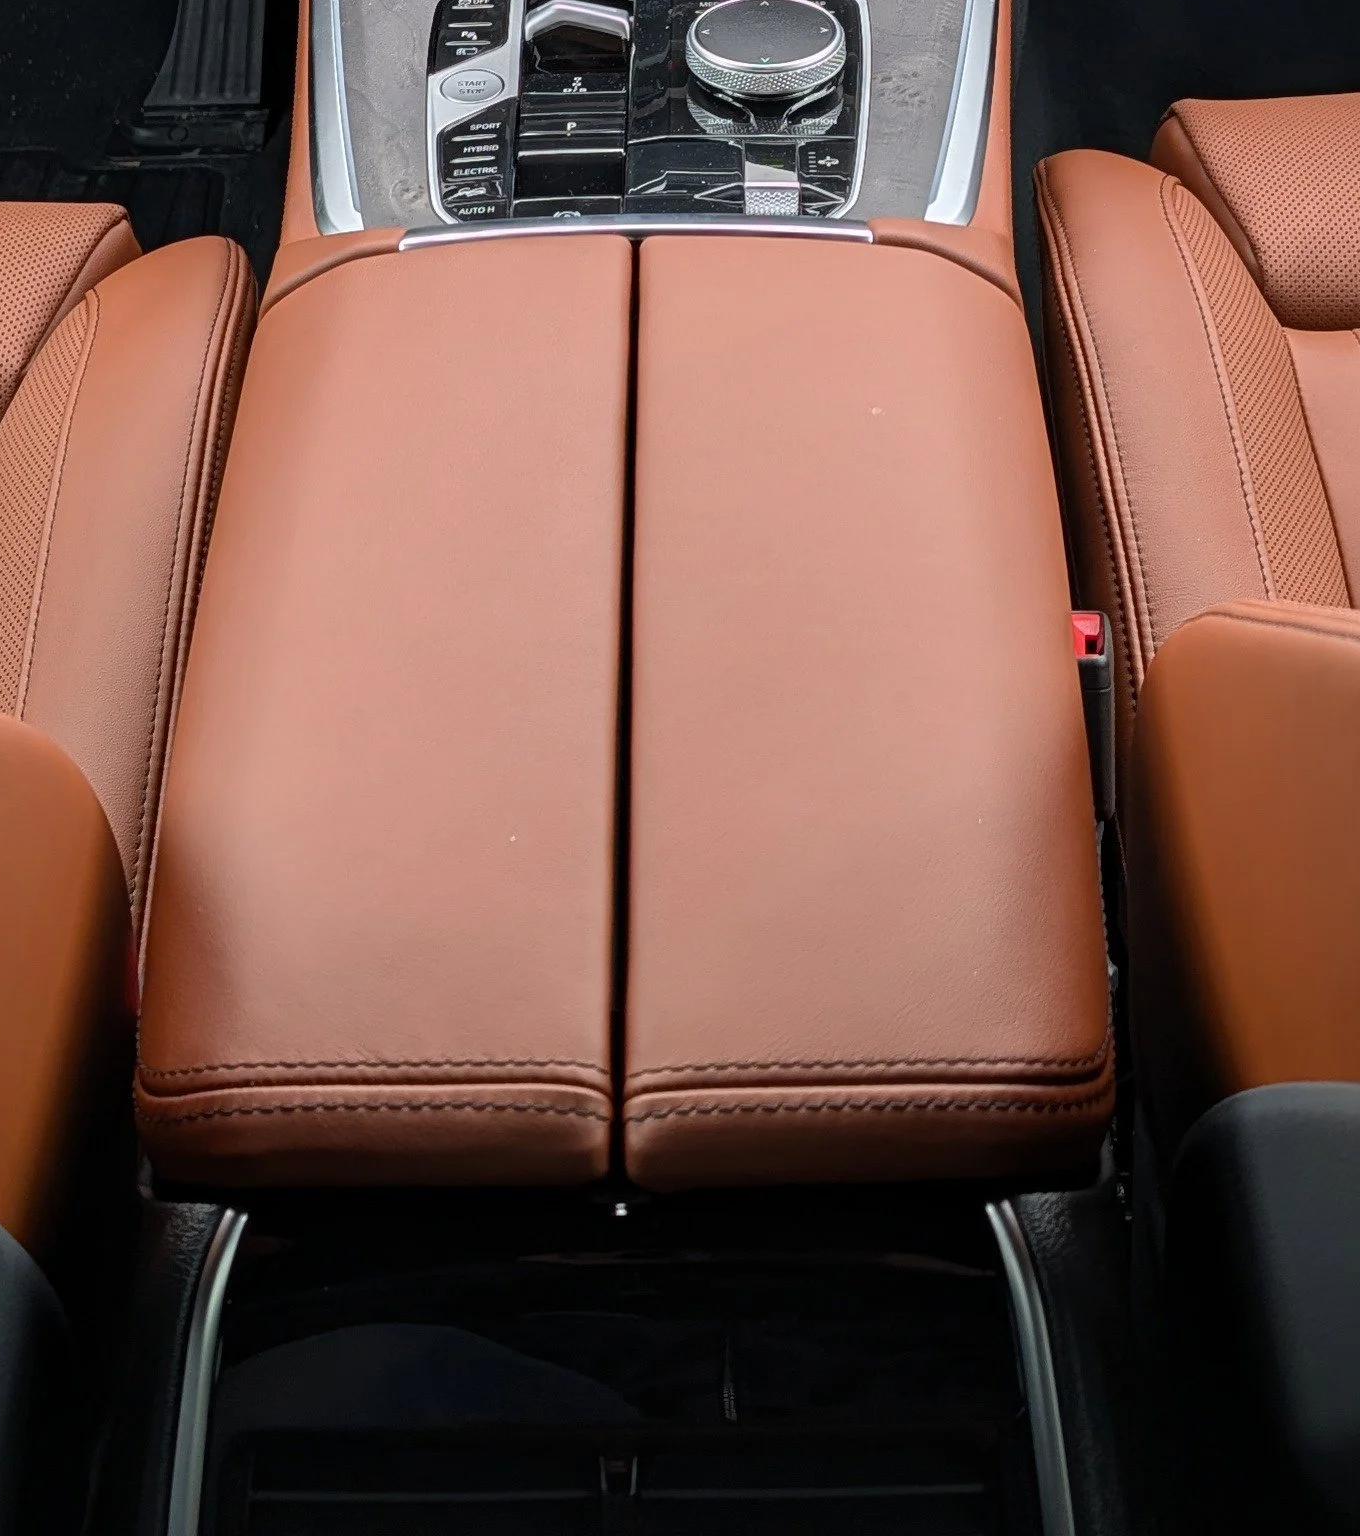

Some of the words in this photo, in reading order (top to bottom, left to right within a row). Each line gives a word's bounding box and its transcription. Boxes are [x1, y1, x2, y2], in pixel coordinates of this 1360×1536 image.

[457, 79, 488, 87] START
[801, 117, 837, 125] OPTION
[469, 122, 502, 131] SPORT
[566, 121, 577, 131] P
[463, 144, 499, 153] HYBRID
[453, 166, 498, 176] ELECTRIC
[458, 206, 486, 215] AUTO
[487, 205, 495, 213] H
